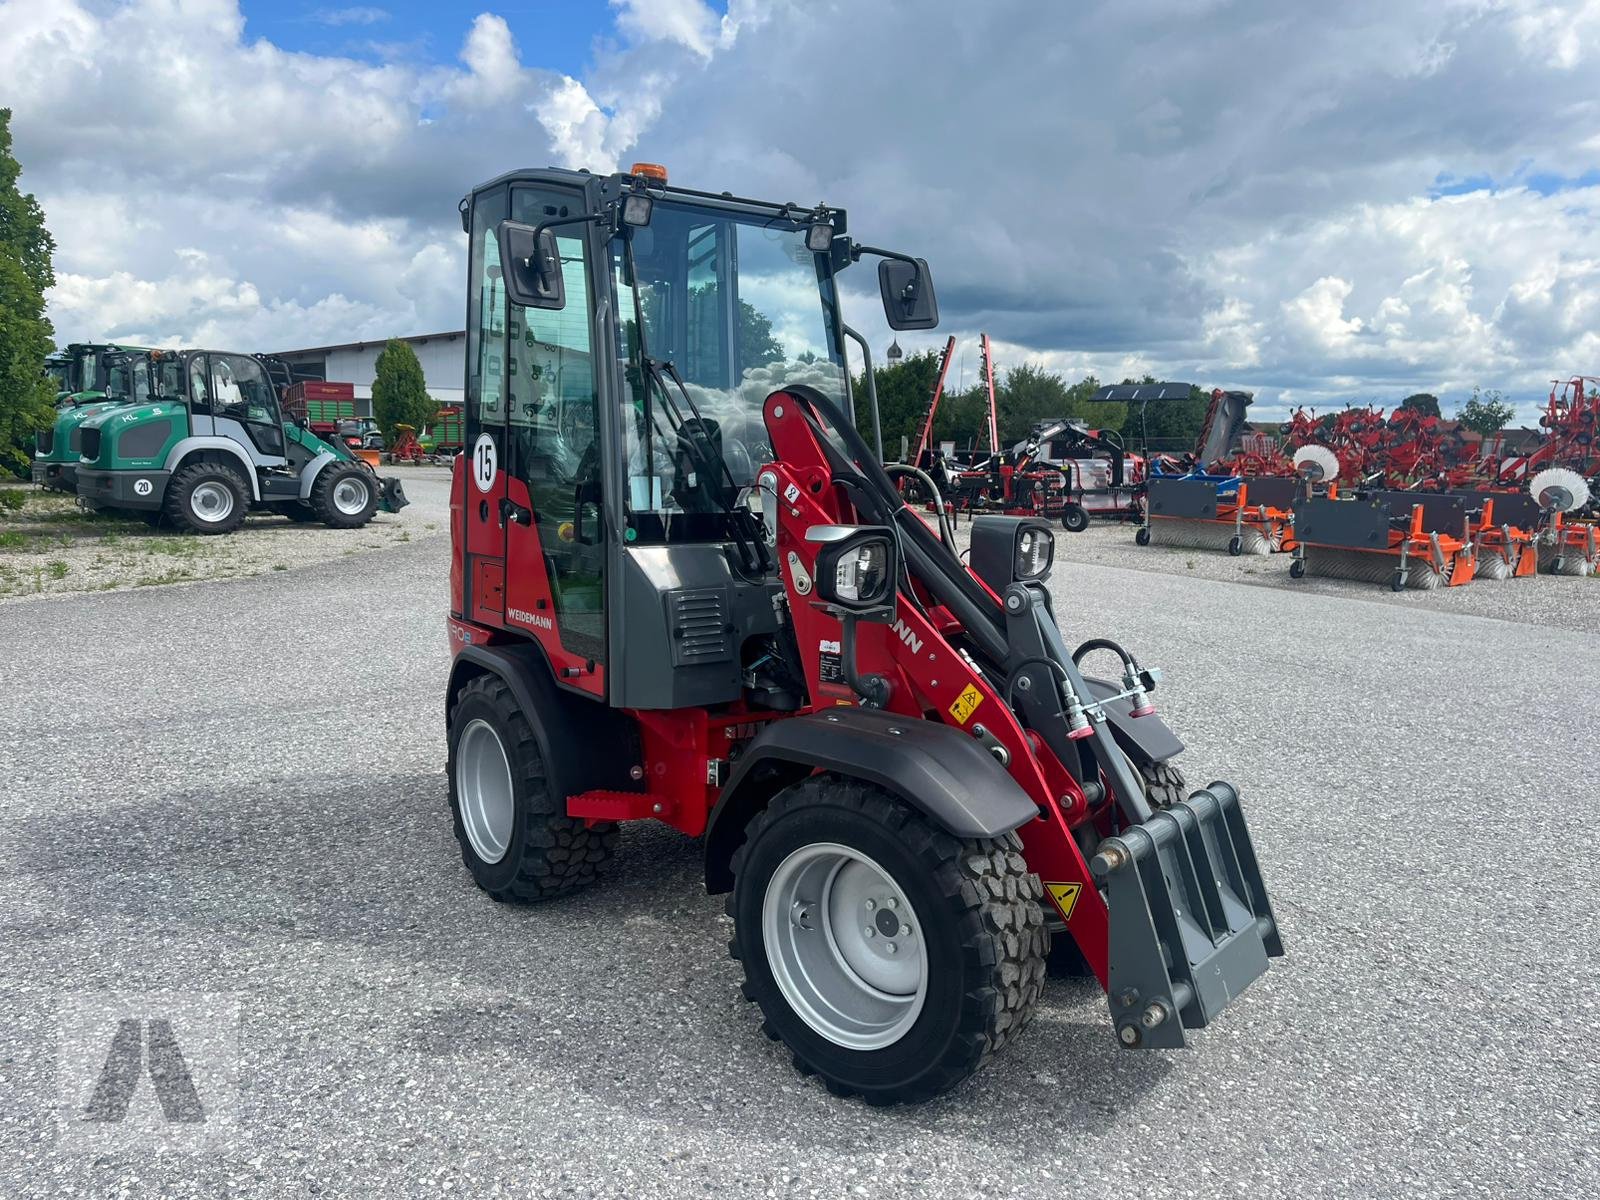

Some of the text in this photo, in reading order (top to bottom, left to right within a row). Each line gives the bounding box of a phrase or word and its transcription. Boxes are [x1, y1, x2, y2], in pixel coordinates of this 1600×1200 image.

[478, 444, 492, 482] 15
[138, 481, 149, 493] 20
[507, 607, 552, 630] WEIDEMANN
